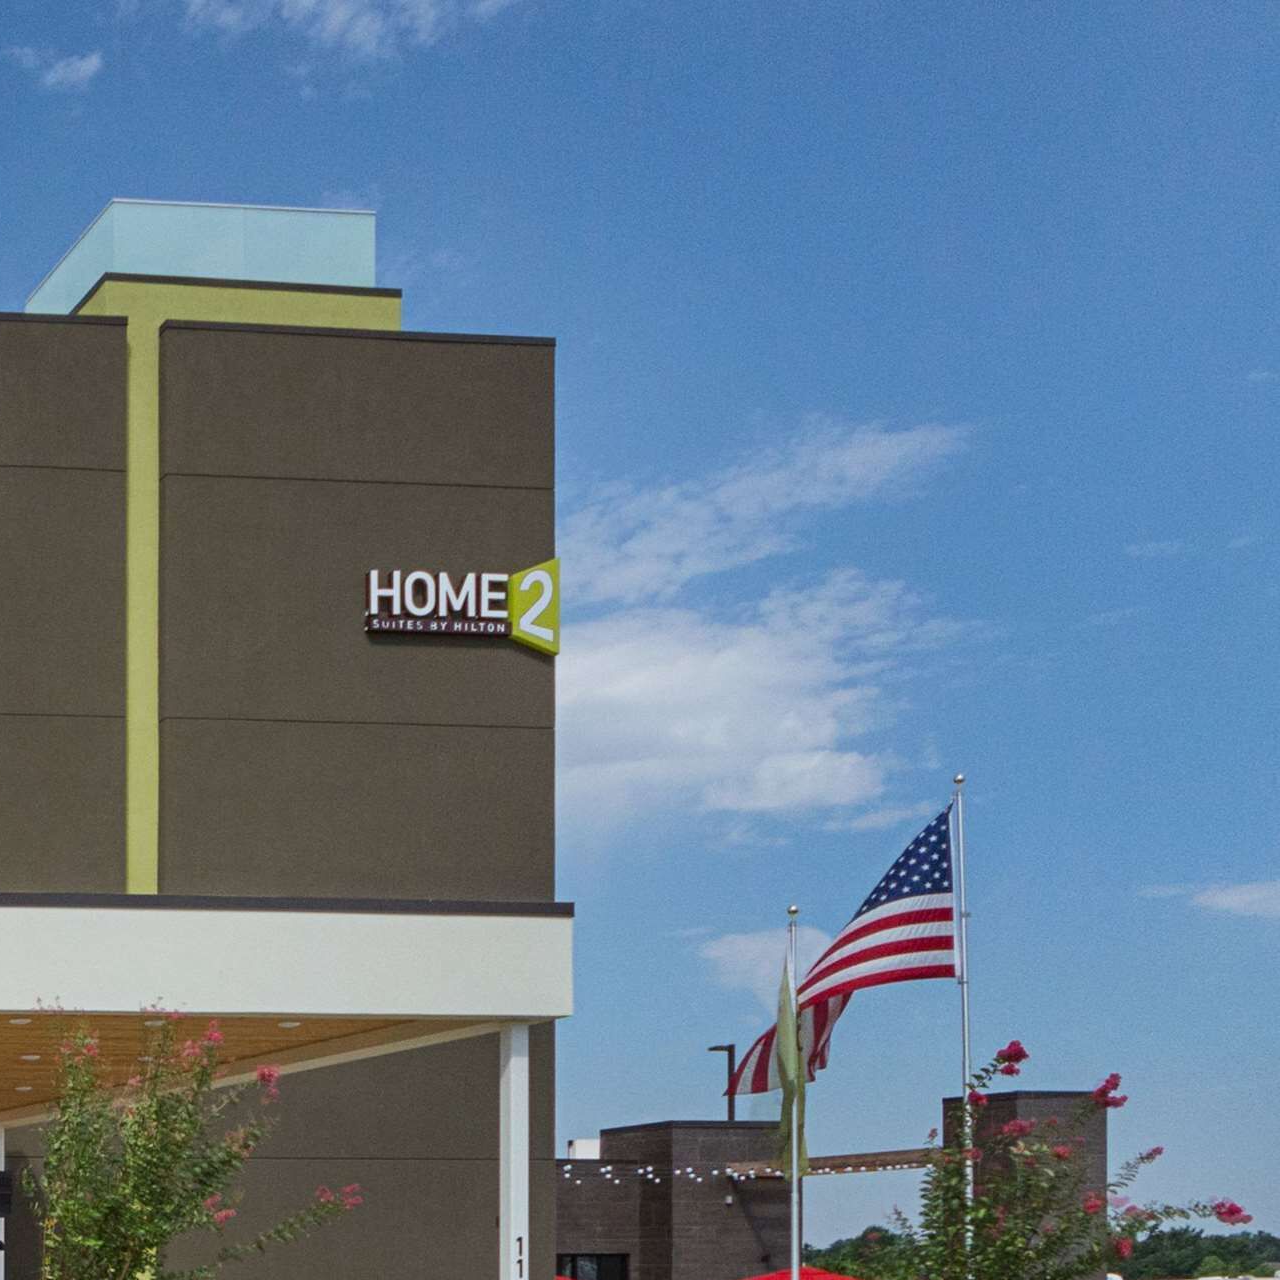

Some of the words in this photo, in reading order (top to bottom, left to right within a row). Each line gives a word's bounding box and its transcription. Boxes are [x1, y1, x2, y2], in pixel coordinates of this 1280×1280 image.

[372, 618, 424, 631] SUITES
[430, 620, 447, 631] BY
[453, 621, 506, 633] HILTON
